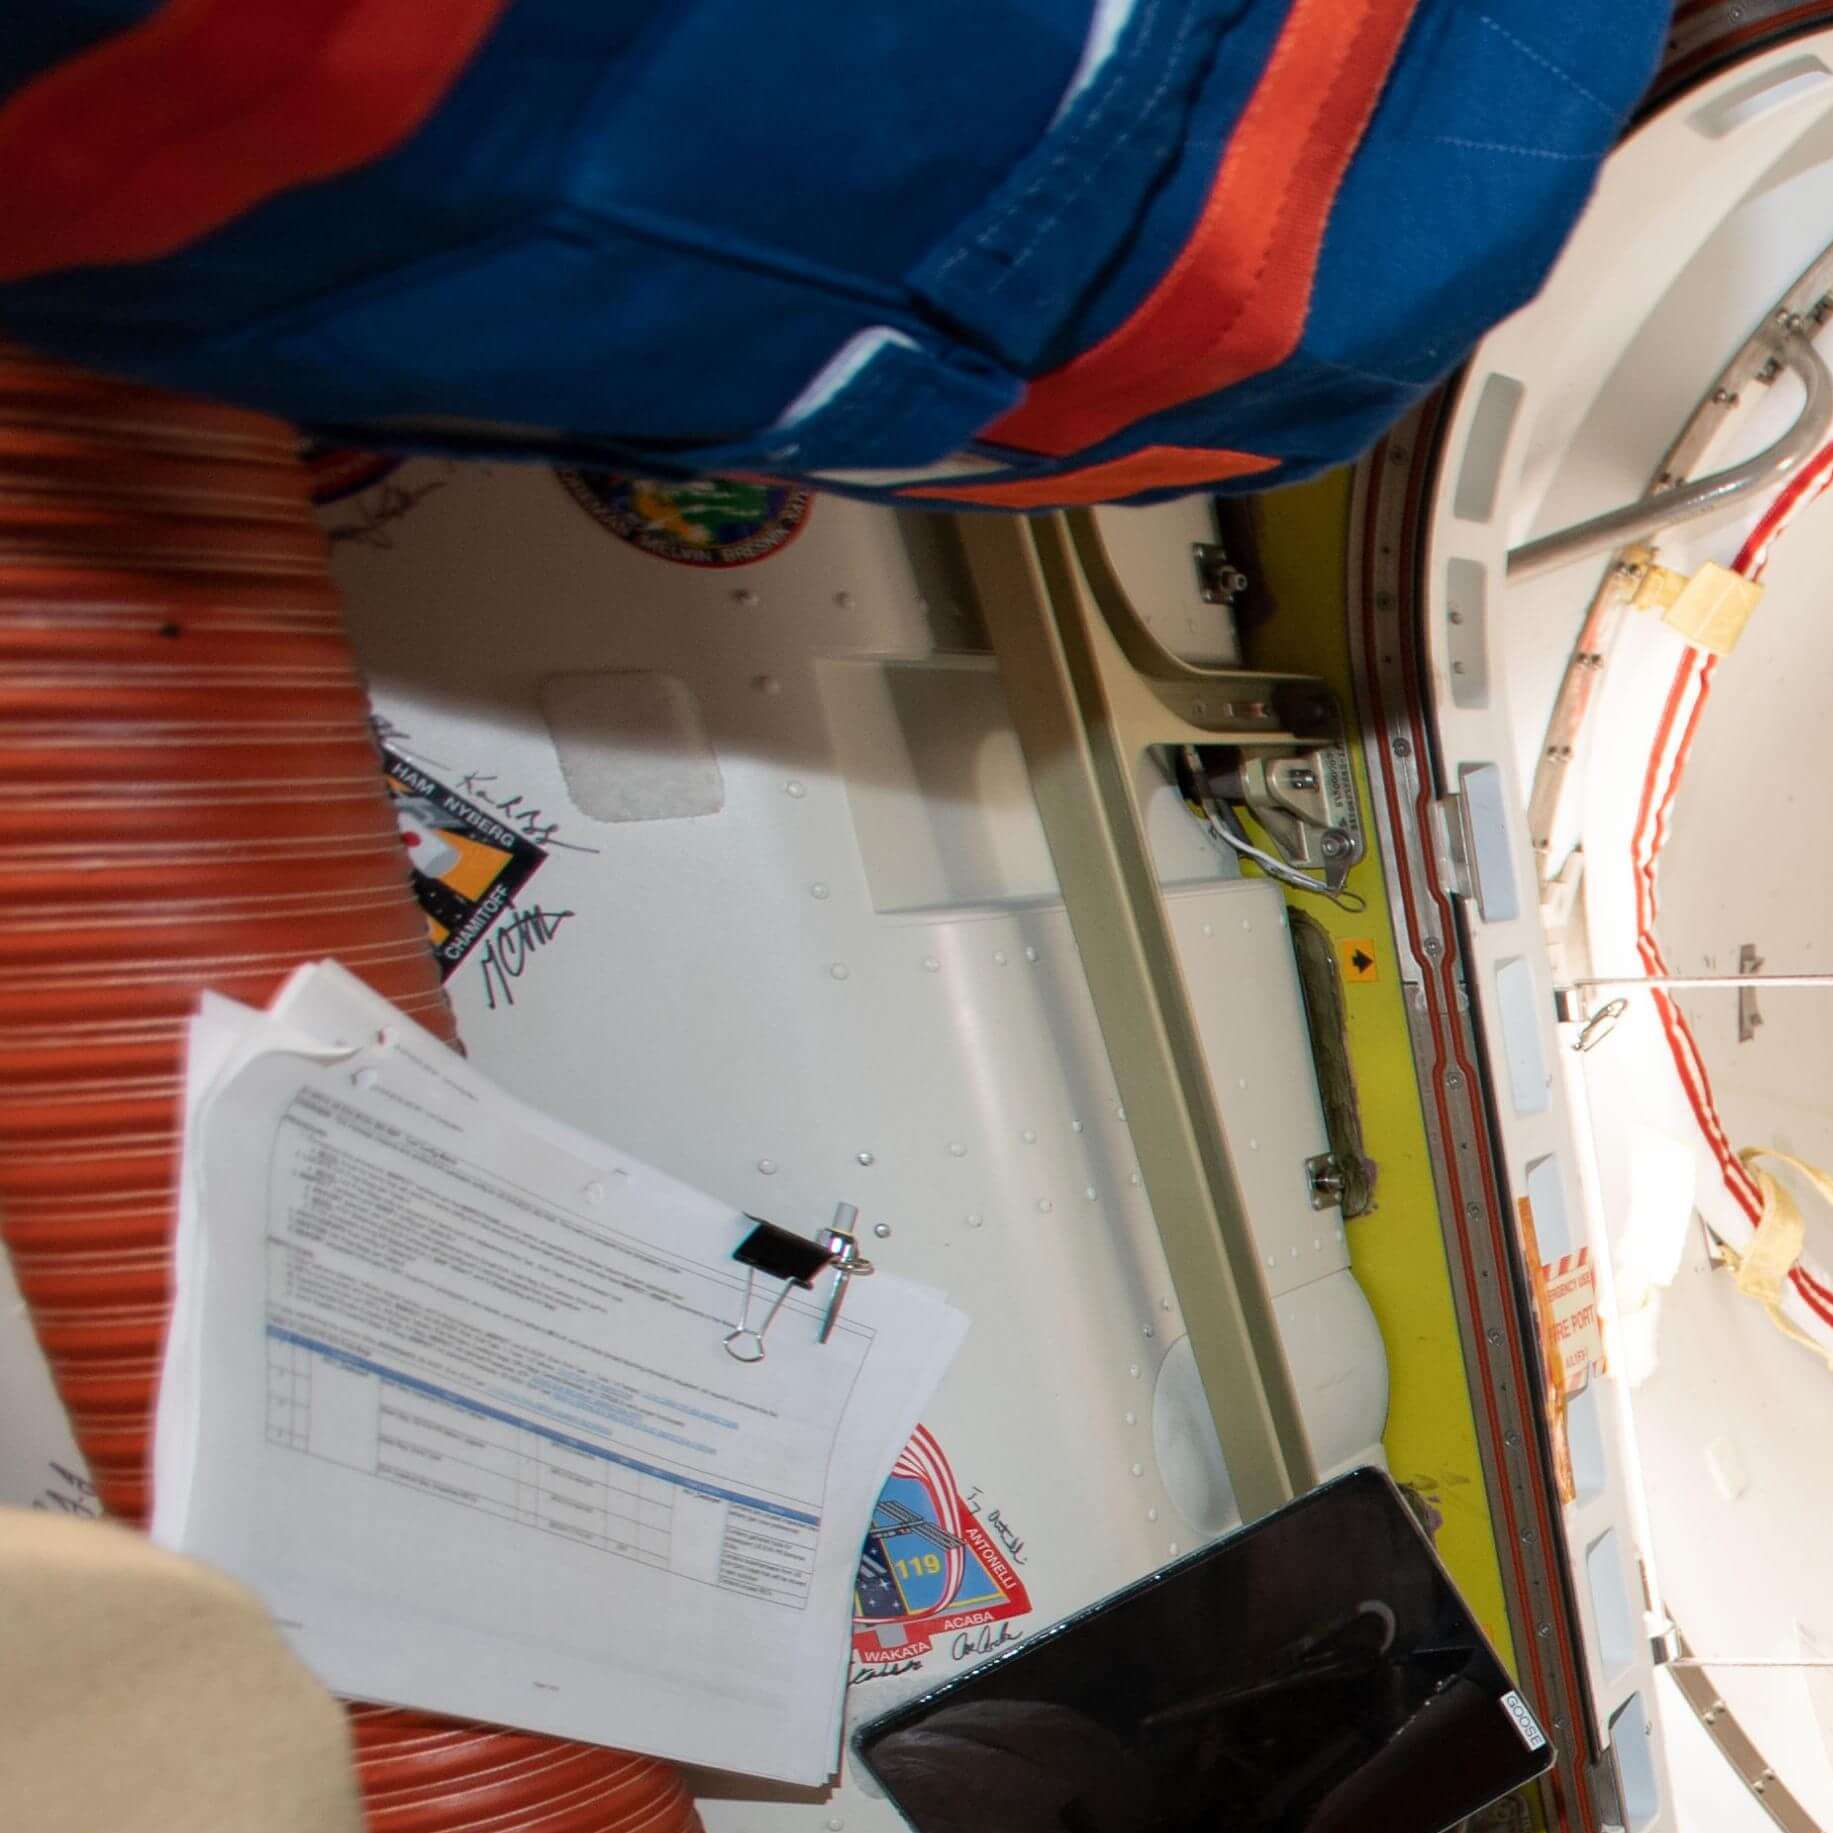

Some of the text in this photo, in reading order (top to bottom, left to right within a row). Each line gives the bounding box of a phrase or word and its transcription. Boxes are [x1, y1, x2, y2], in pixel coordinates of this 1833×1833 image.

[443, 796, 515, 848] NYBERG
[895, 1554, 941, 1580] 119
[965, 1527, 1017, 1590] ANTONELLI
[943, 1610, 995, 1632] ACABA
[863, 1641, 930, 1663] WAKATA
[1506, 1695, 1543, 1746] GOOSE
